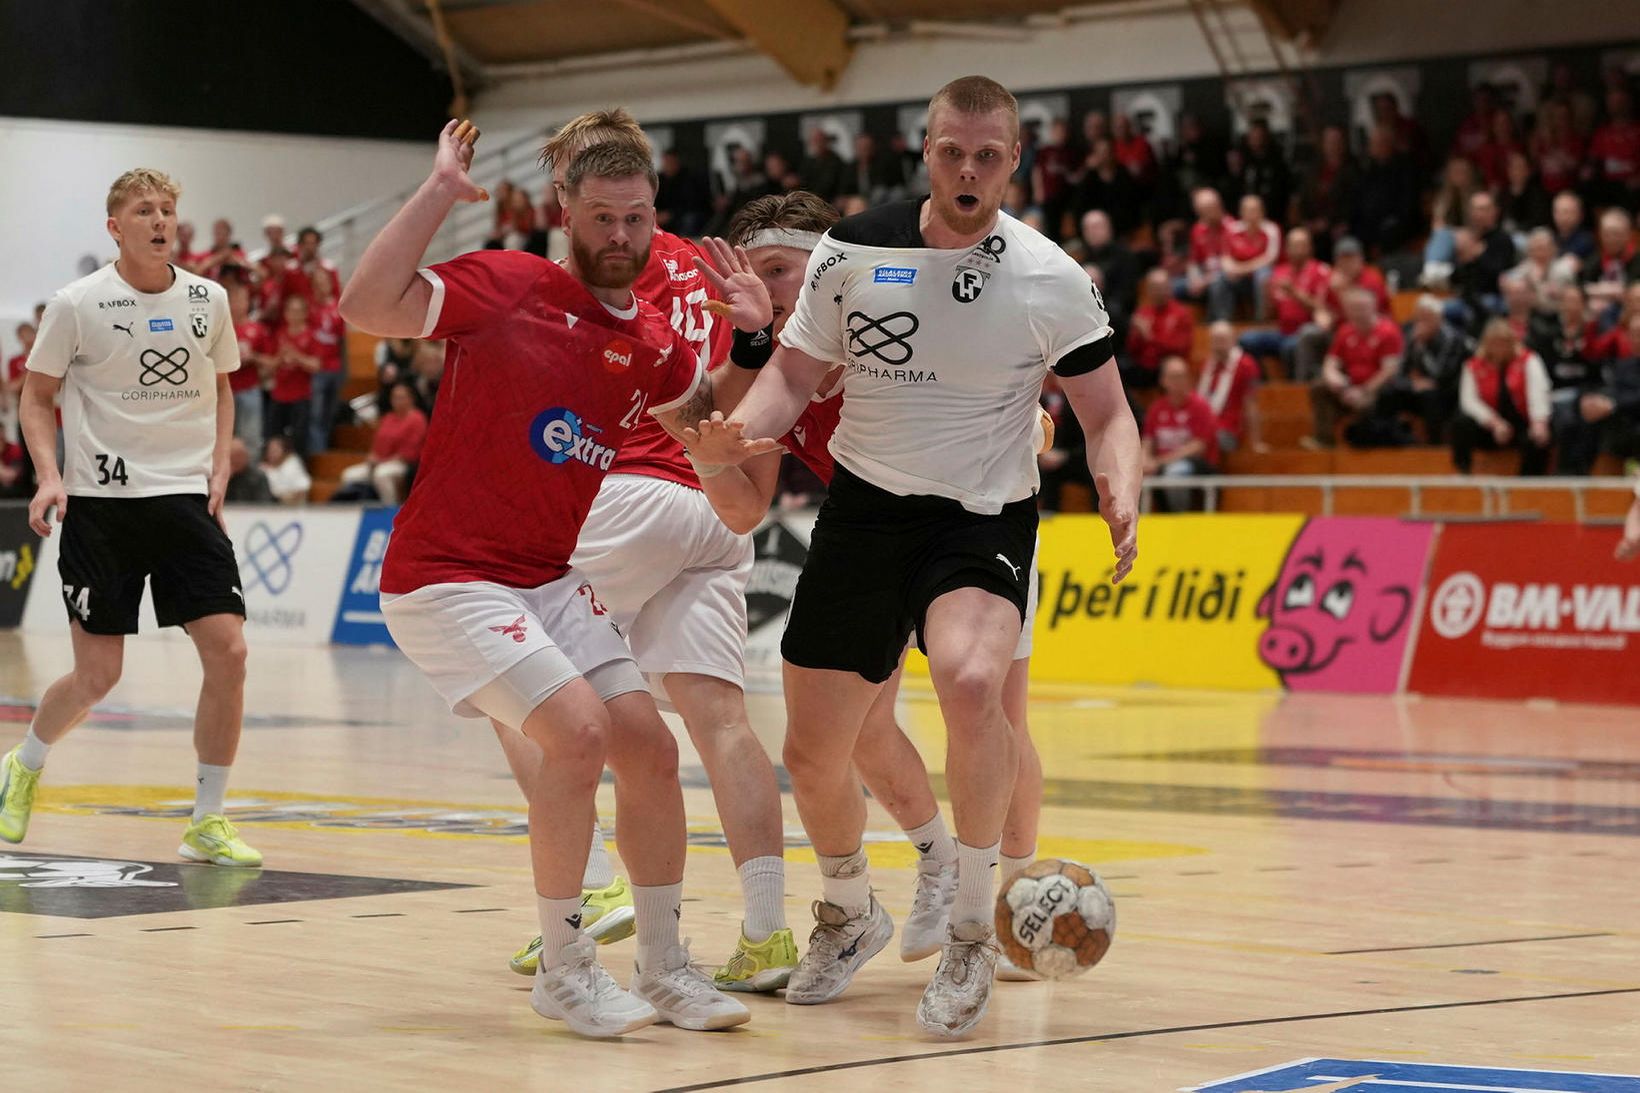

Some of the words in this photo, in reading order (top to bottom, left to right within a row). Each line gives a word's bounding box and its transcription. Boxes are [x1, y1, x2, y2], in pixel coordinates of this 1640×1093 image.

[604, 349, 632, 367] epal
[121, 389, 201, 401] CORIPHARMA
[543, 419, 616, 471] extra
[95, 454, 128, 486] 34
[1050, 566, 1138, 630] þér
[1143, 566, 1169, 620] í
[1167, 567, 1245, 622] liði
[1019, 880, 1070, 944] SELECT
